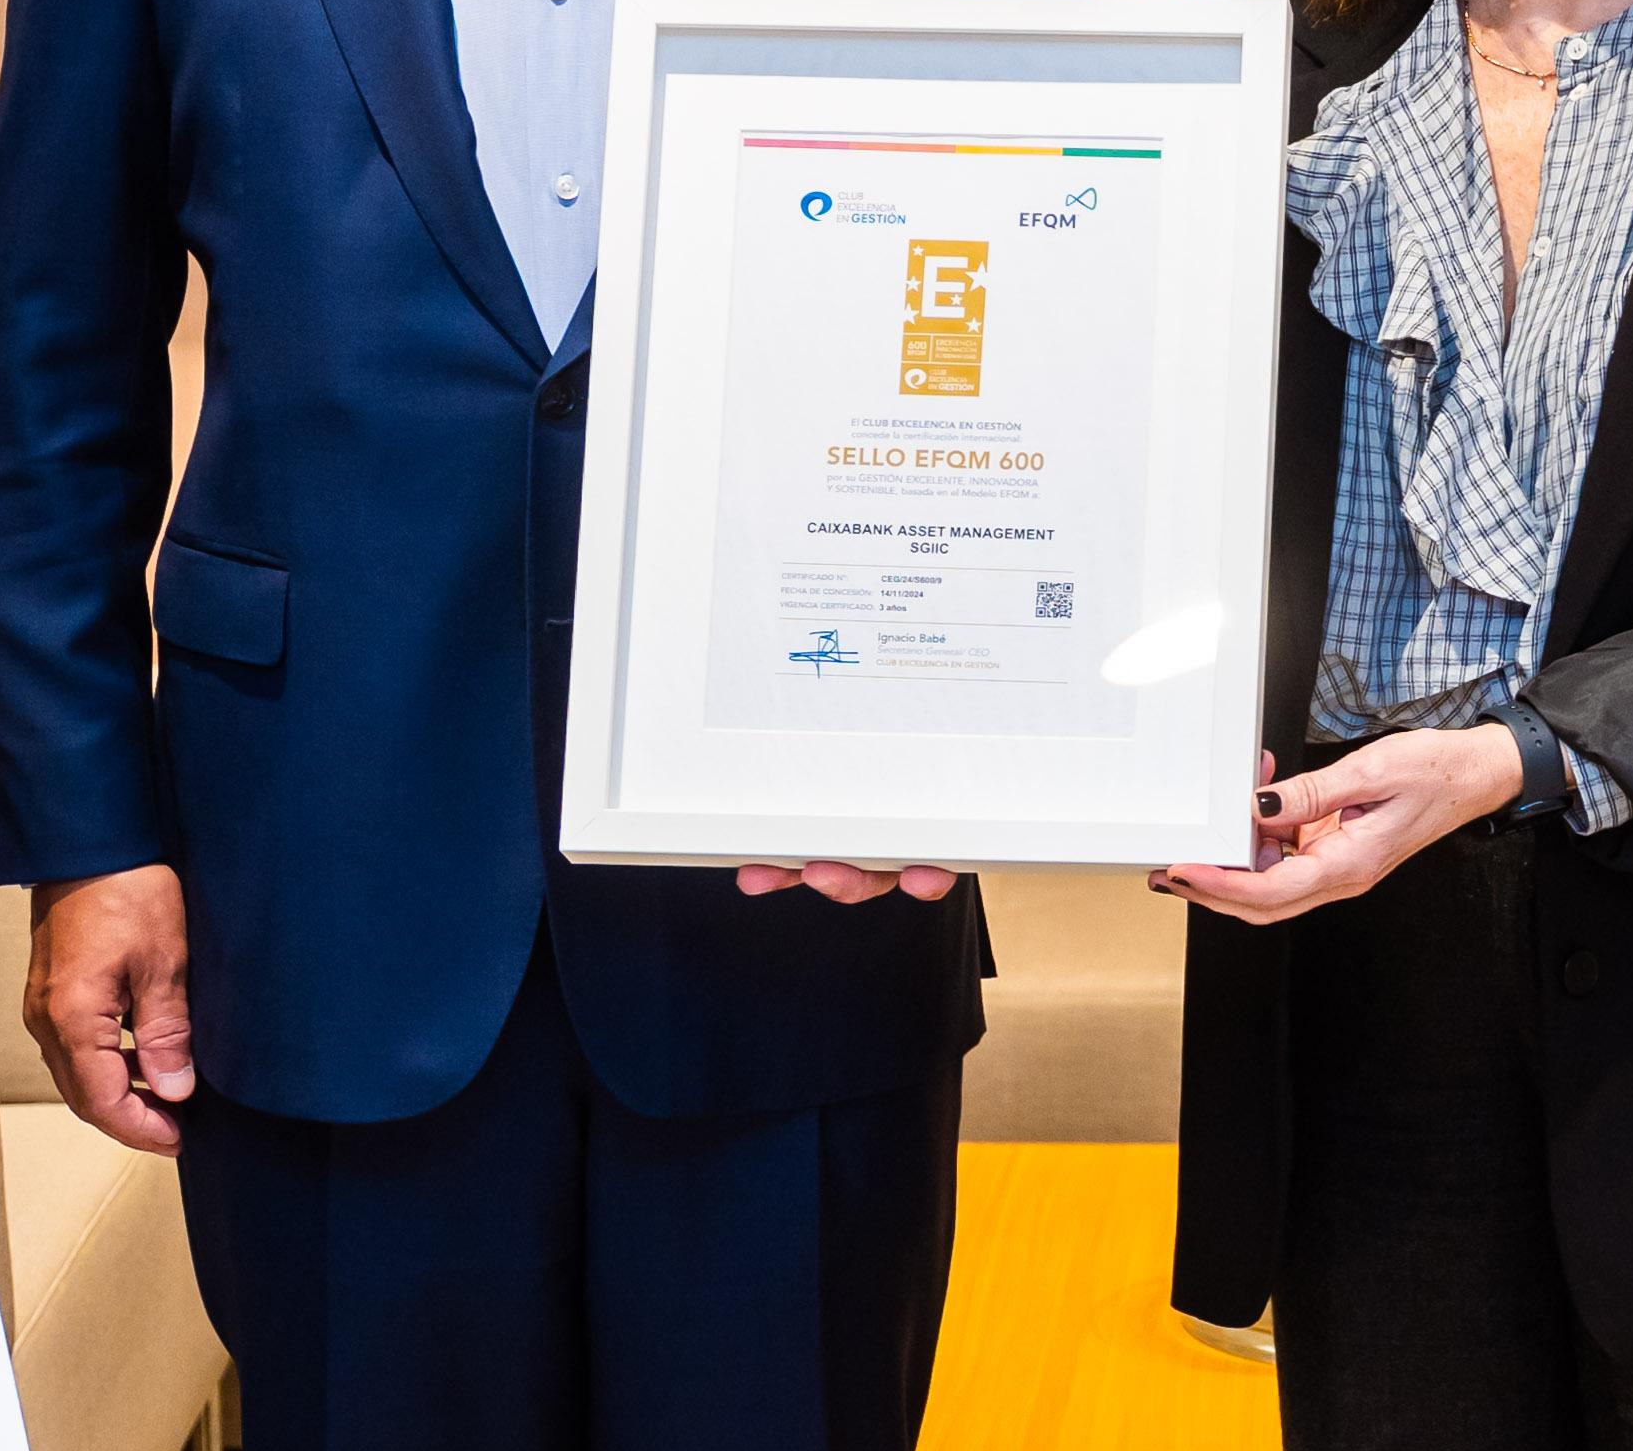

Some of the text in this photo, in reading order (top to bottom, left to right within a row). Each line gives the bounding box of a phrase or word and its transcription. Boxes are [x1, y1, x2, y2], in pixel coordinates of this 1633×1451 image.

[838, 192, 863, 200] CLUB
[837, 202, 897, 212] EXCELENCIA
[837, 212, 906, 224] EN GESTIÓN
[1019, 212, 1076, 229] EFQM
[921, 256, 969, 318] E
[863, 418, 888, 428] CLUB
[891, 420, 955, 429] EXCELENCIA
[959, 421, 973, 430] EN
[976, 421, 1022, 430] GESTIÓN
[851, 431, 891, 440] concede
[893, 431, 901, 440] la
[903, 432, 959, 442] certificación
[827, 446, 1045, 471] SELLO EFQM 600
[827, 474, 843, 484] por
[858, 473, 903, 484] GESTIÓN
[969, 476, 1039, 487] INNOVADORA
[827, 484, 833, 492] Y
[901, 487, 935, 496] basada
[951, 488, 959, 497] el
[961, 488, 997, 498] Modelo
[1000, 489, 1029, 499] EFQM
[807, 522, 1055, 540] CAIXABANK ASSET MANAGEMENT
[910, 542, 949, 554] SGIIC
[781, 572, 834, 581] CERTIFICADO
[781, 586, 807, 595] FECHA
[809, 588, 821, 596] DE
[881, 590, 924, 598] 14/11/2024
[779, 601, 817, 610] VIGENCIA
[879, 603, 907, 612] 3 años
[877, 632, 946, 644] Ignacio Babé
[877, 645, 924, 656] Secretario
[969, 648, 991, 657] CEO
[875, 658, 897, 666] CLUB
[899, 659, 949, 668] EXCELENCIA
